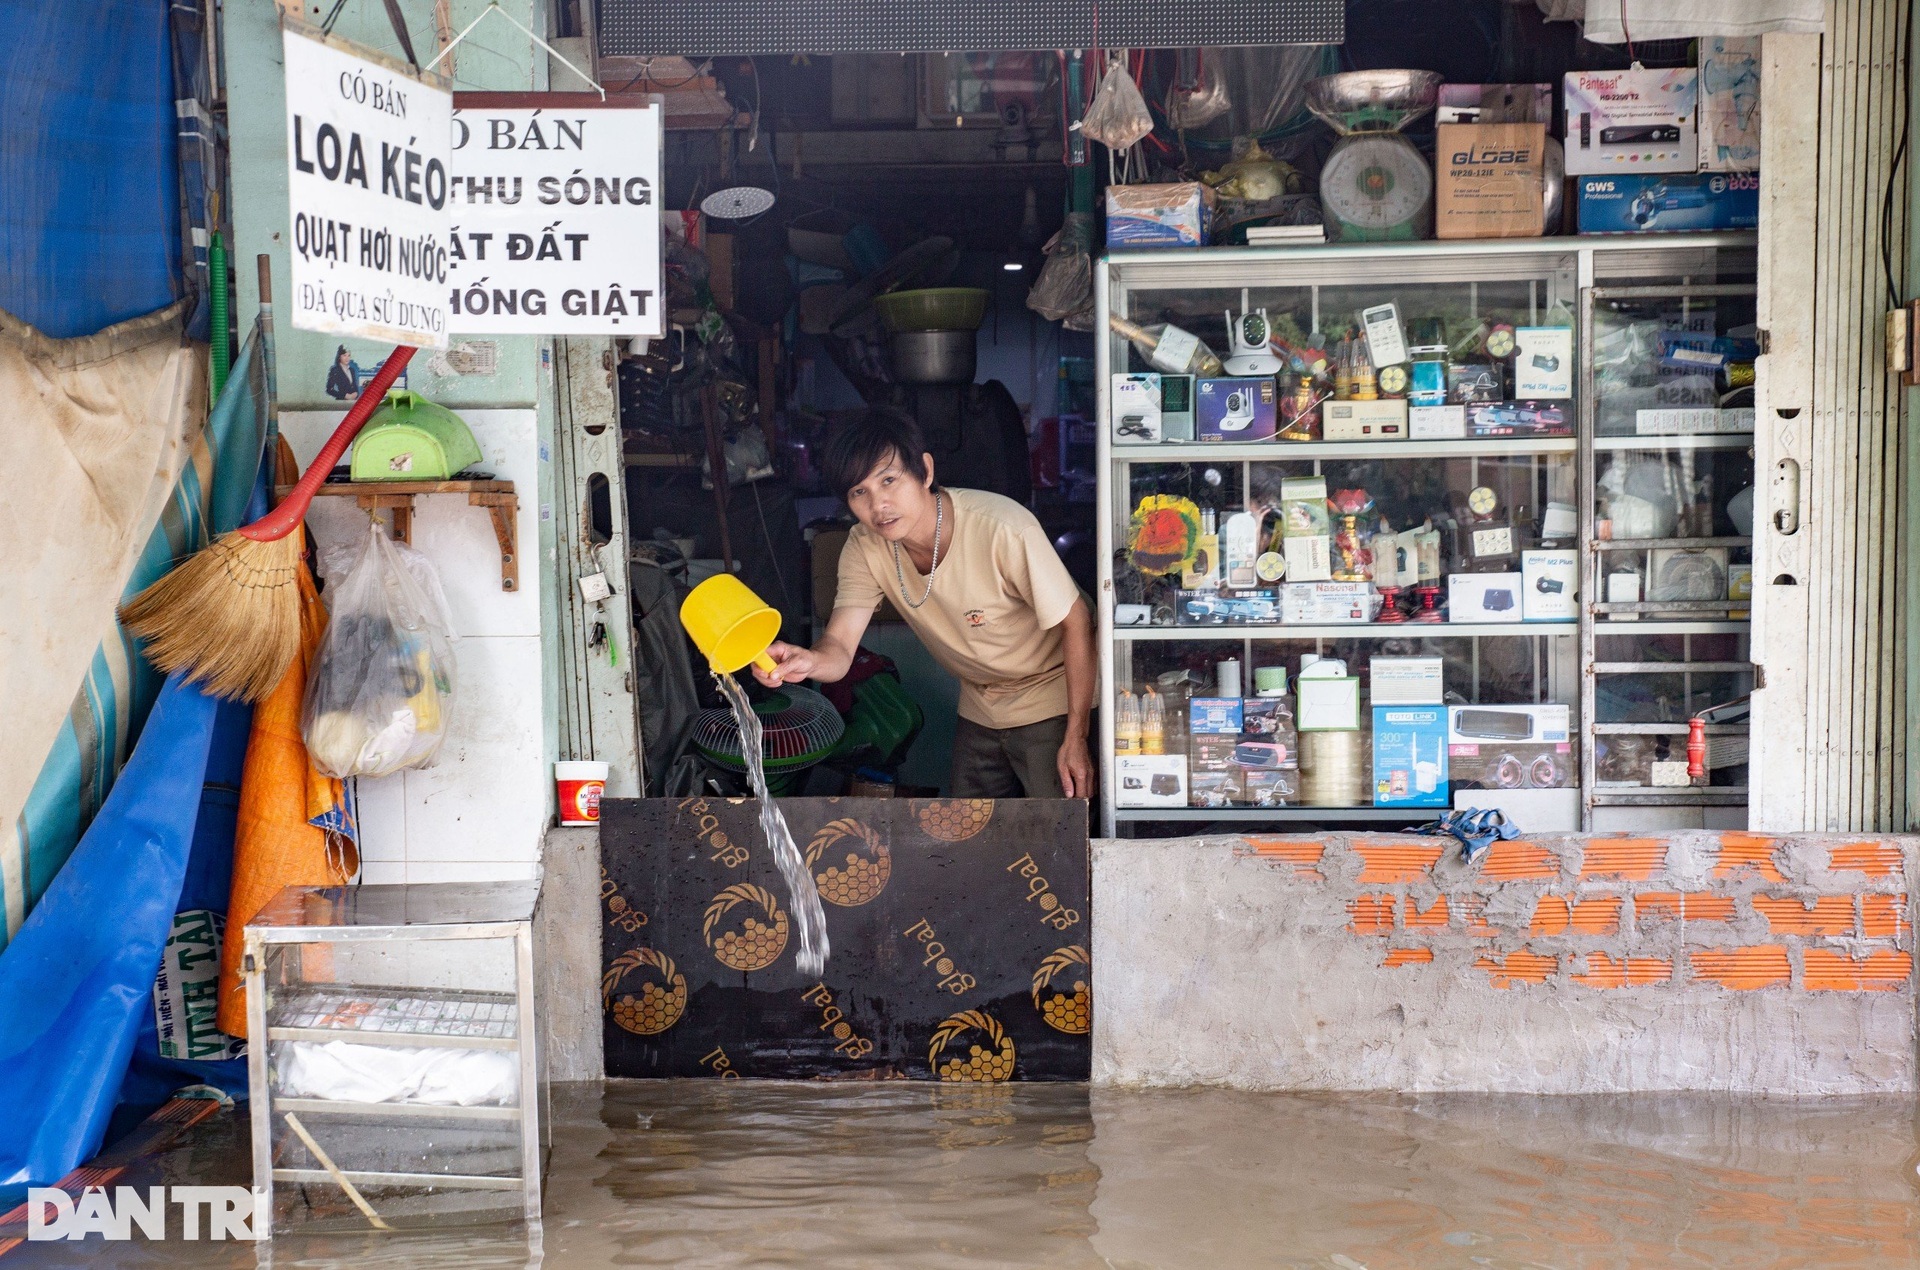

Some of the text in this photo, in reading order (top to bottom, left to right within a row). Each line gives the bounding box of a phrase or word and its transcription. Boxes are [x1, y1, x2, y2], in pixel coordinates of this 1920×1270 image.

[340, 68, 407, 119] CÓ BÁN
[452, 109, 586, 150] Ó BÁN
[294, 114, 447, 211] LOA KÉO
[1452, 142, 1530, 165] GLOBE
[537, 168, 651, 206] SÓNG
[1584, 192, 1624, 200] Professional
[1585, 182, 1615, 192] GWS
[295, 211, 447, 285] QUẠT HƠI NƯỚC
[506, 220, 589, 261] ĐẤT
[297, 280, 446, 336] (ĐÃ QUA SỬ DỤNG)
[561, 283, 653, 325] GIẬT
[1380, 732, 1400, 743] 300
[1006, 852, 1080, 931] global
[903, 917, 976, 995] global
[800, 982, 873, 1060] global
